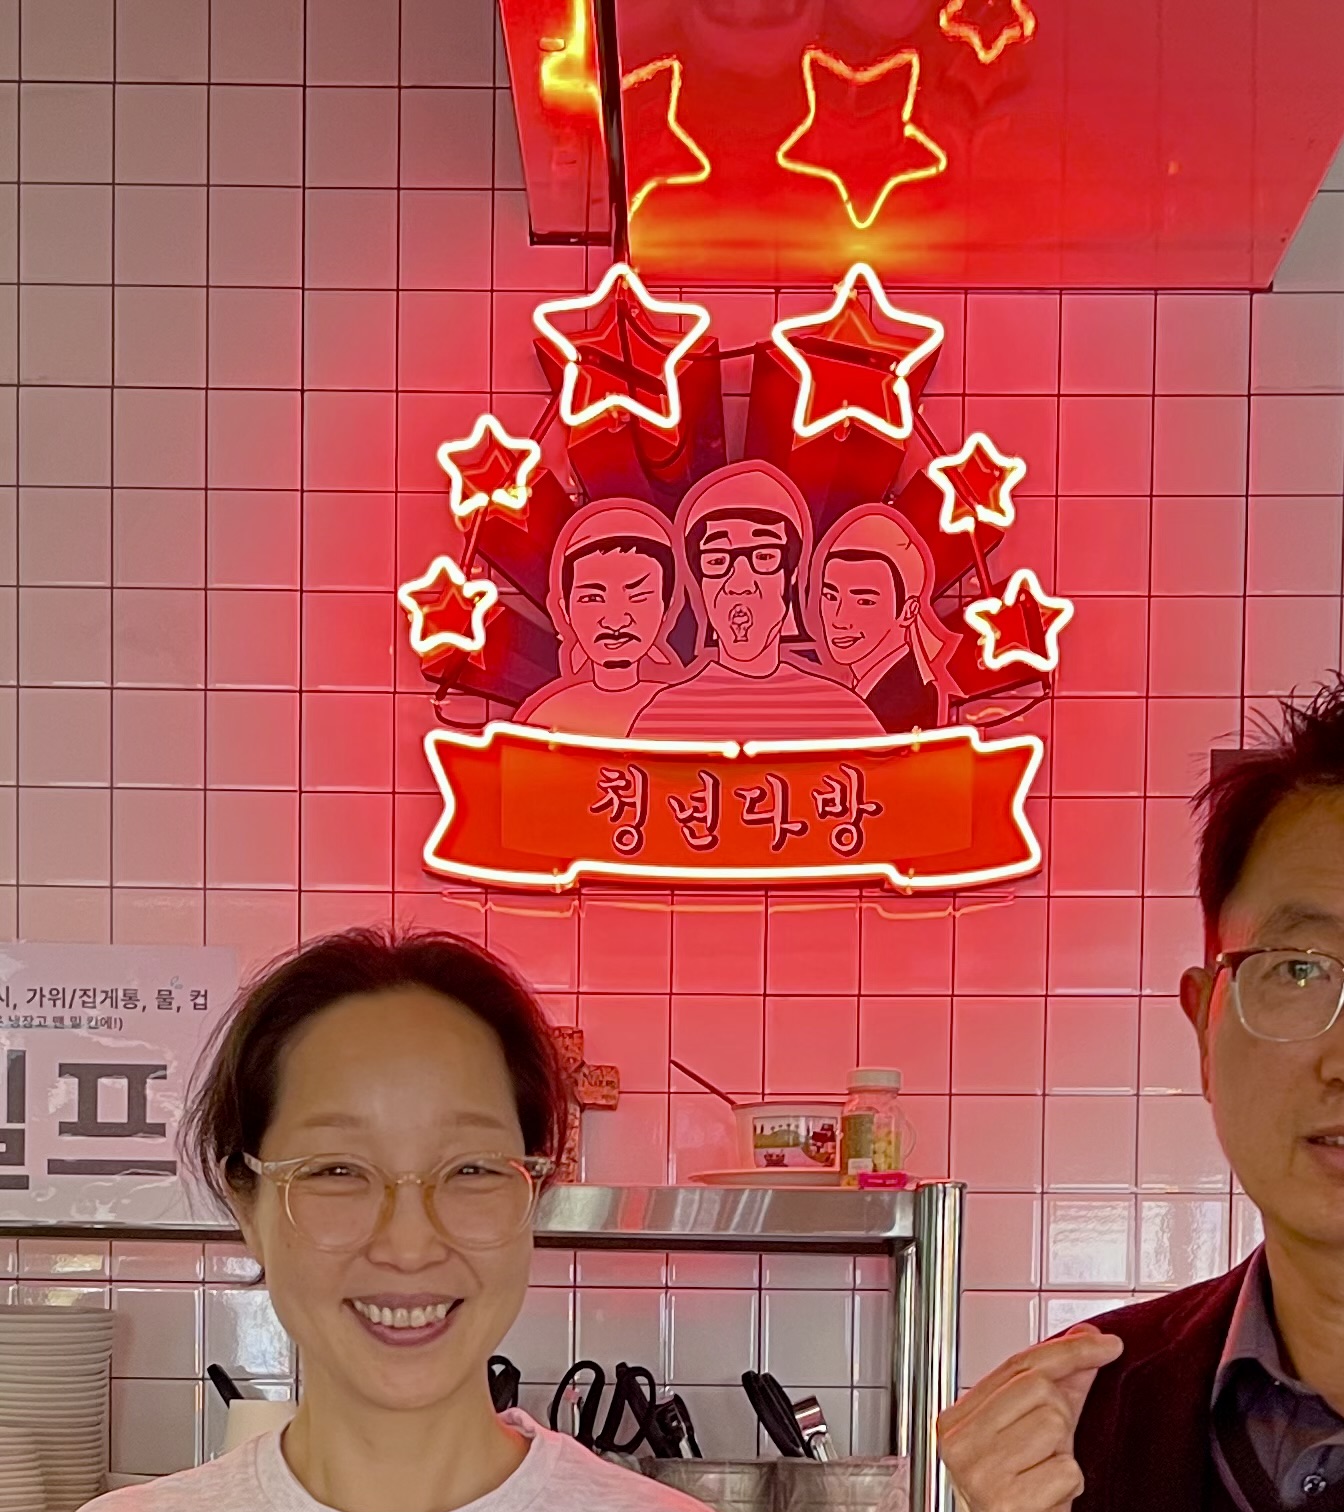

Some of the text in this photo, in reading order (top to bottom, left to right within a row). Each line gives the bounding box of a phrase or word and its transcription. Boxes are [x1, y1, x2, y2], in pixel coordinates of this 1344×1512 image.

[590, 763, 883, 858] 청년다방
[26, 986, 146, 1013] 가위/집게통,
[155, 988, 182, 1013] 물,
[189, 988, 208, 1011] 컵
